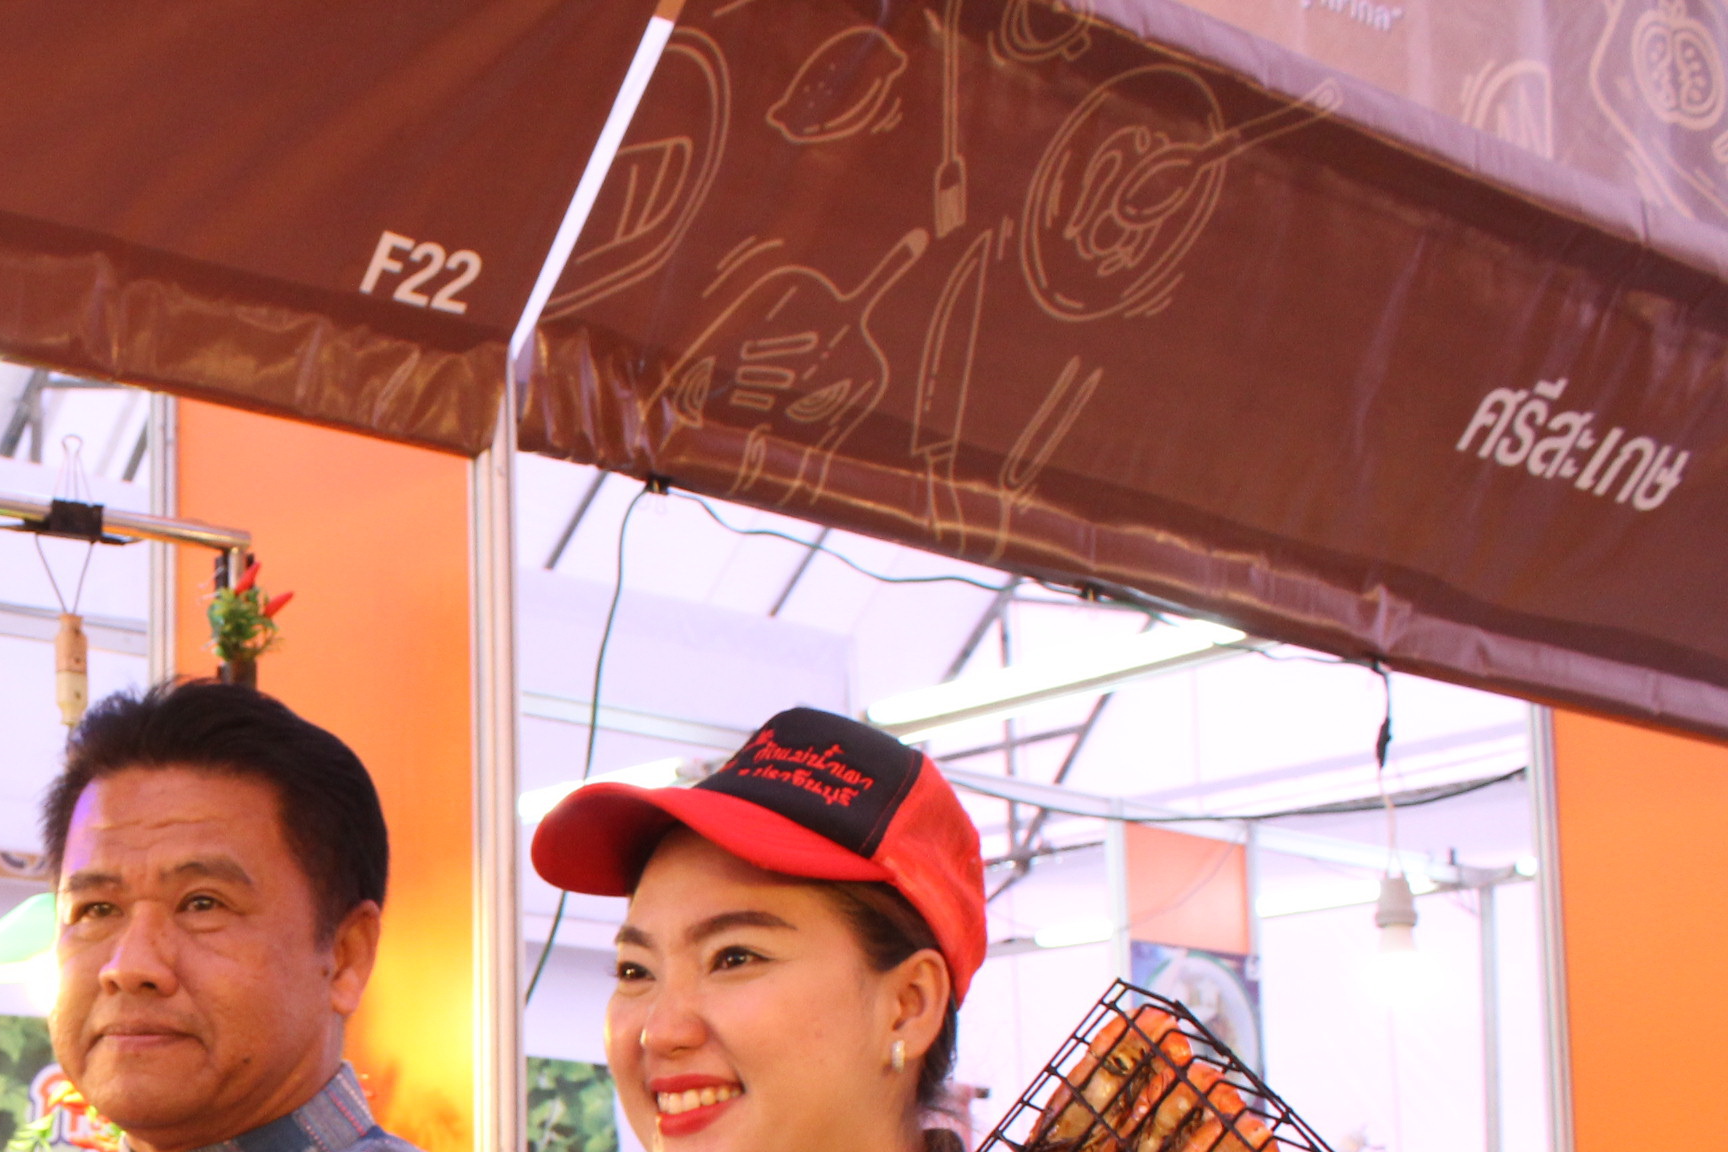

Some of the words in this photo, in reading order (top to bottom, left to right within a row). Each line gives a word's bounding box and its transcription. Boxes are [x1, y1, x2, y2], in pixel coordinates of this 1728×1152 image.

[359, 230, 483, 315] F22
[1456, 377, 1689, 511] ศรีสะเกษ
